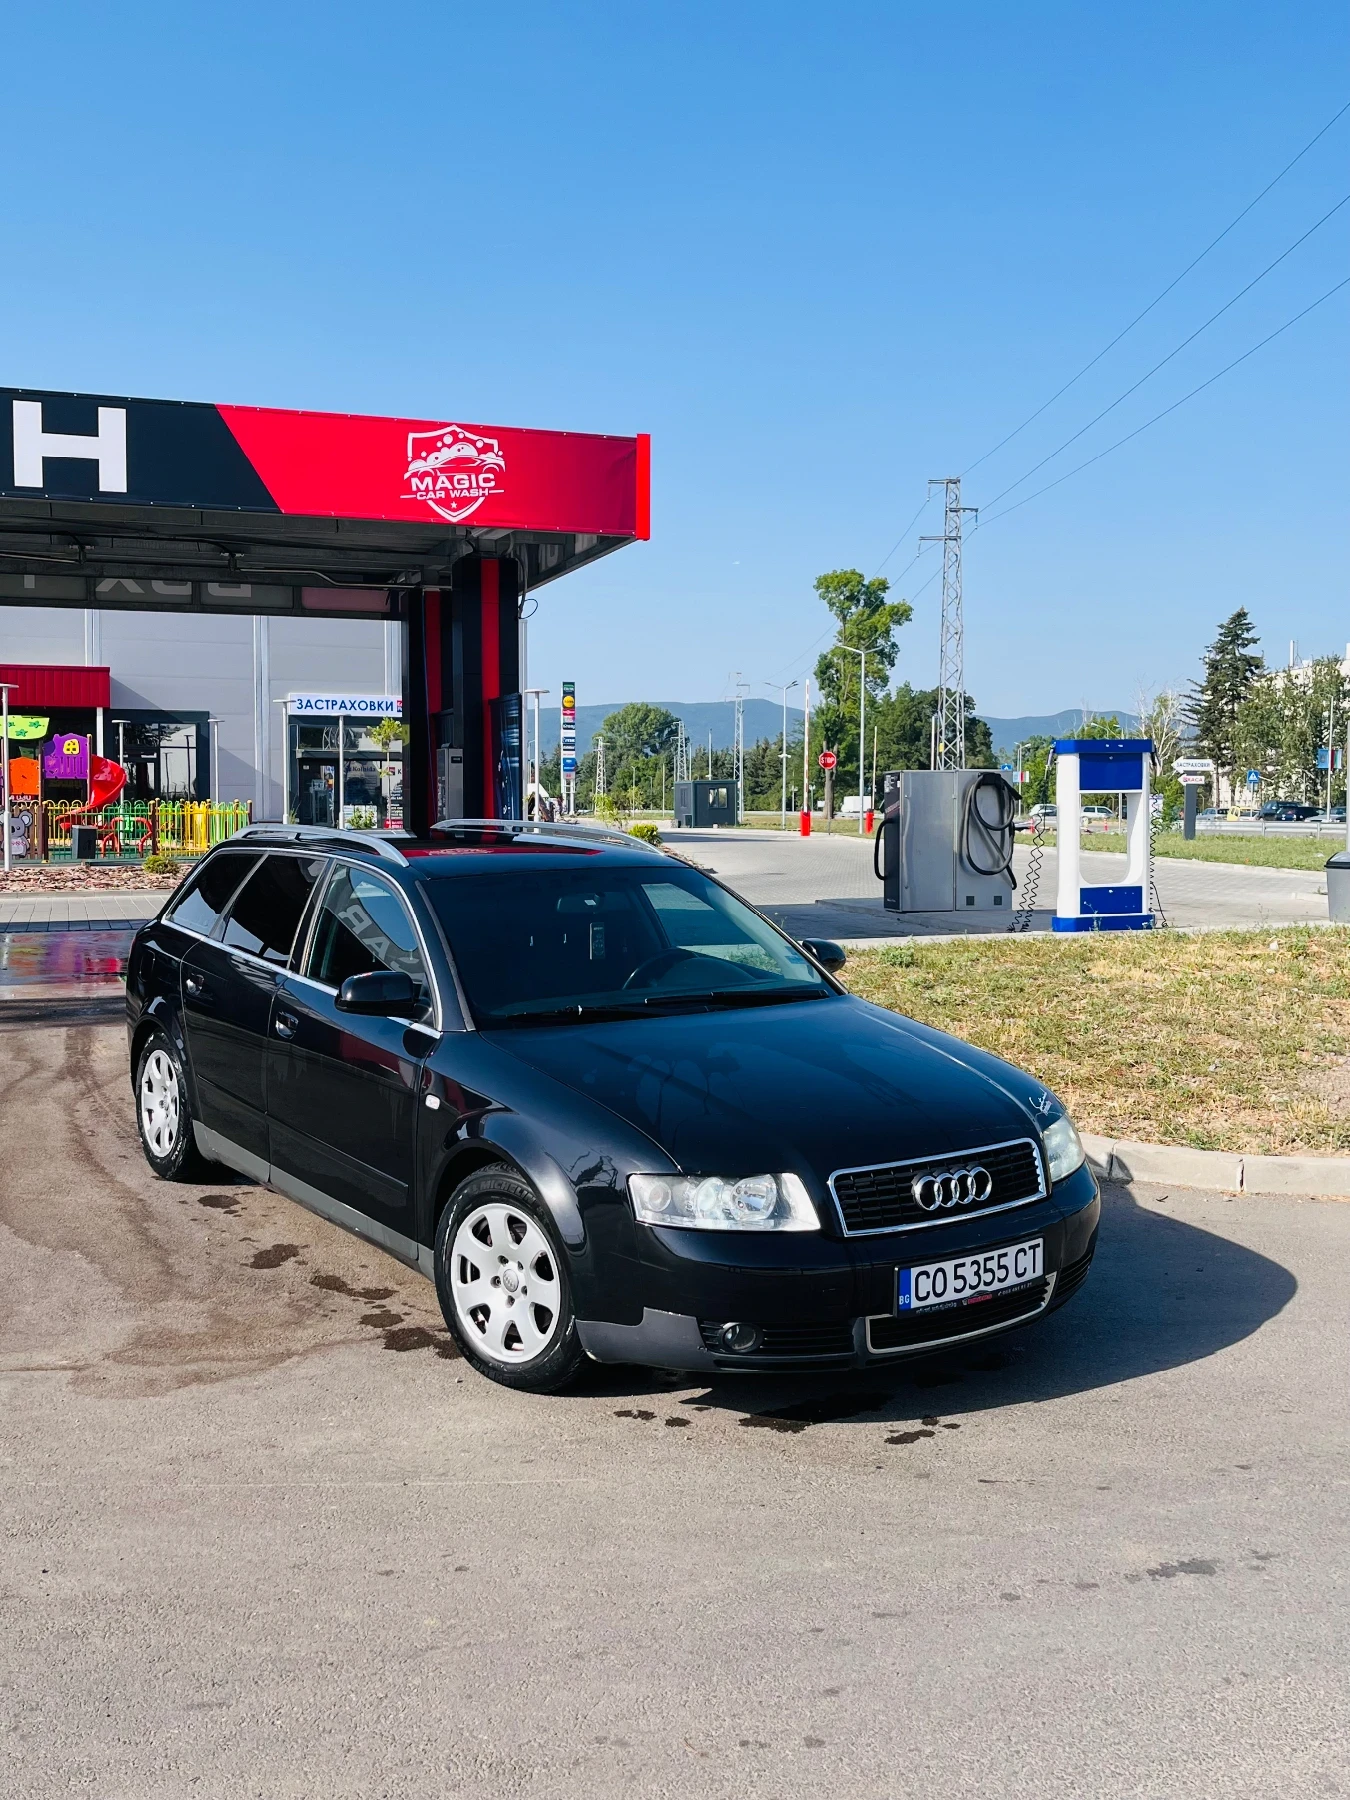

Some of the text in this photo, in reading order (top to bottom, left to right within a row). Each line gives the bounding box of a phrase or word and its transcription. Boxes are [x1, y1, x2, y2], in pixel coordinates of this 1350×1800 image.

[12, 399, 127, 493] H
[410, 473, 496, 492] MAGIC
[416, 488, 489, 500] CAR WASH
[296, 698, 394, 712] ЗАСТРАХОВКИ
[914, 1242, 1040, 1302] CO 5355 CT
[899, 1294, 910, 1305] BG
